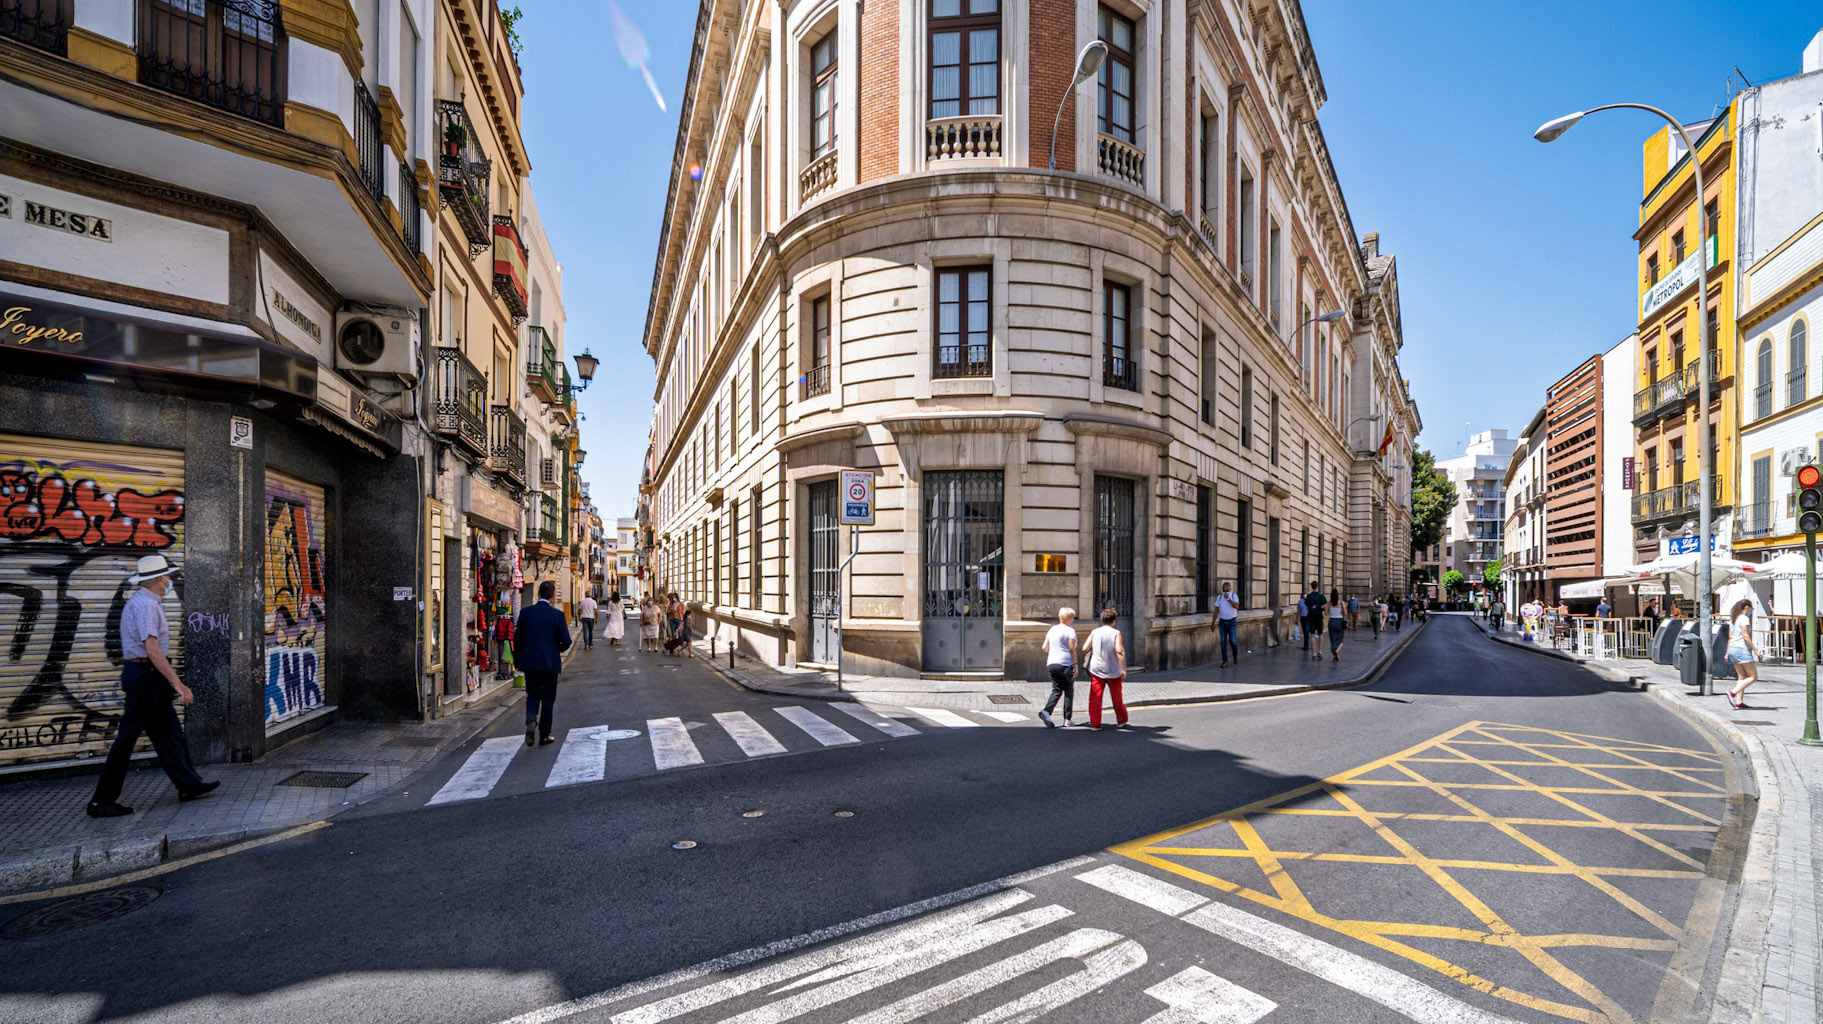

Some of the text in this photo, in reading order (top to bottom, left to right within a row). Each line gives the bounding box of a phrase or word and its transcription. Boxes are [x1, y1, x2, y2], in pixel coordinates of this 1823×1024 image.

[26, 202, 109, 239] MESA
[1653, 277, 1684, 307] METROPOL
[0, 307, 83, 344] Joyero
